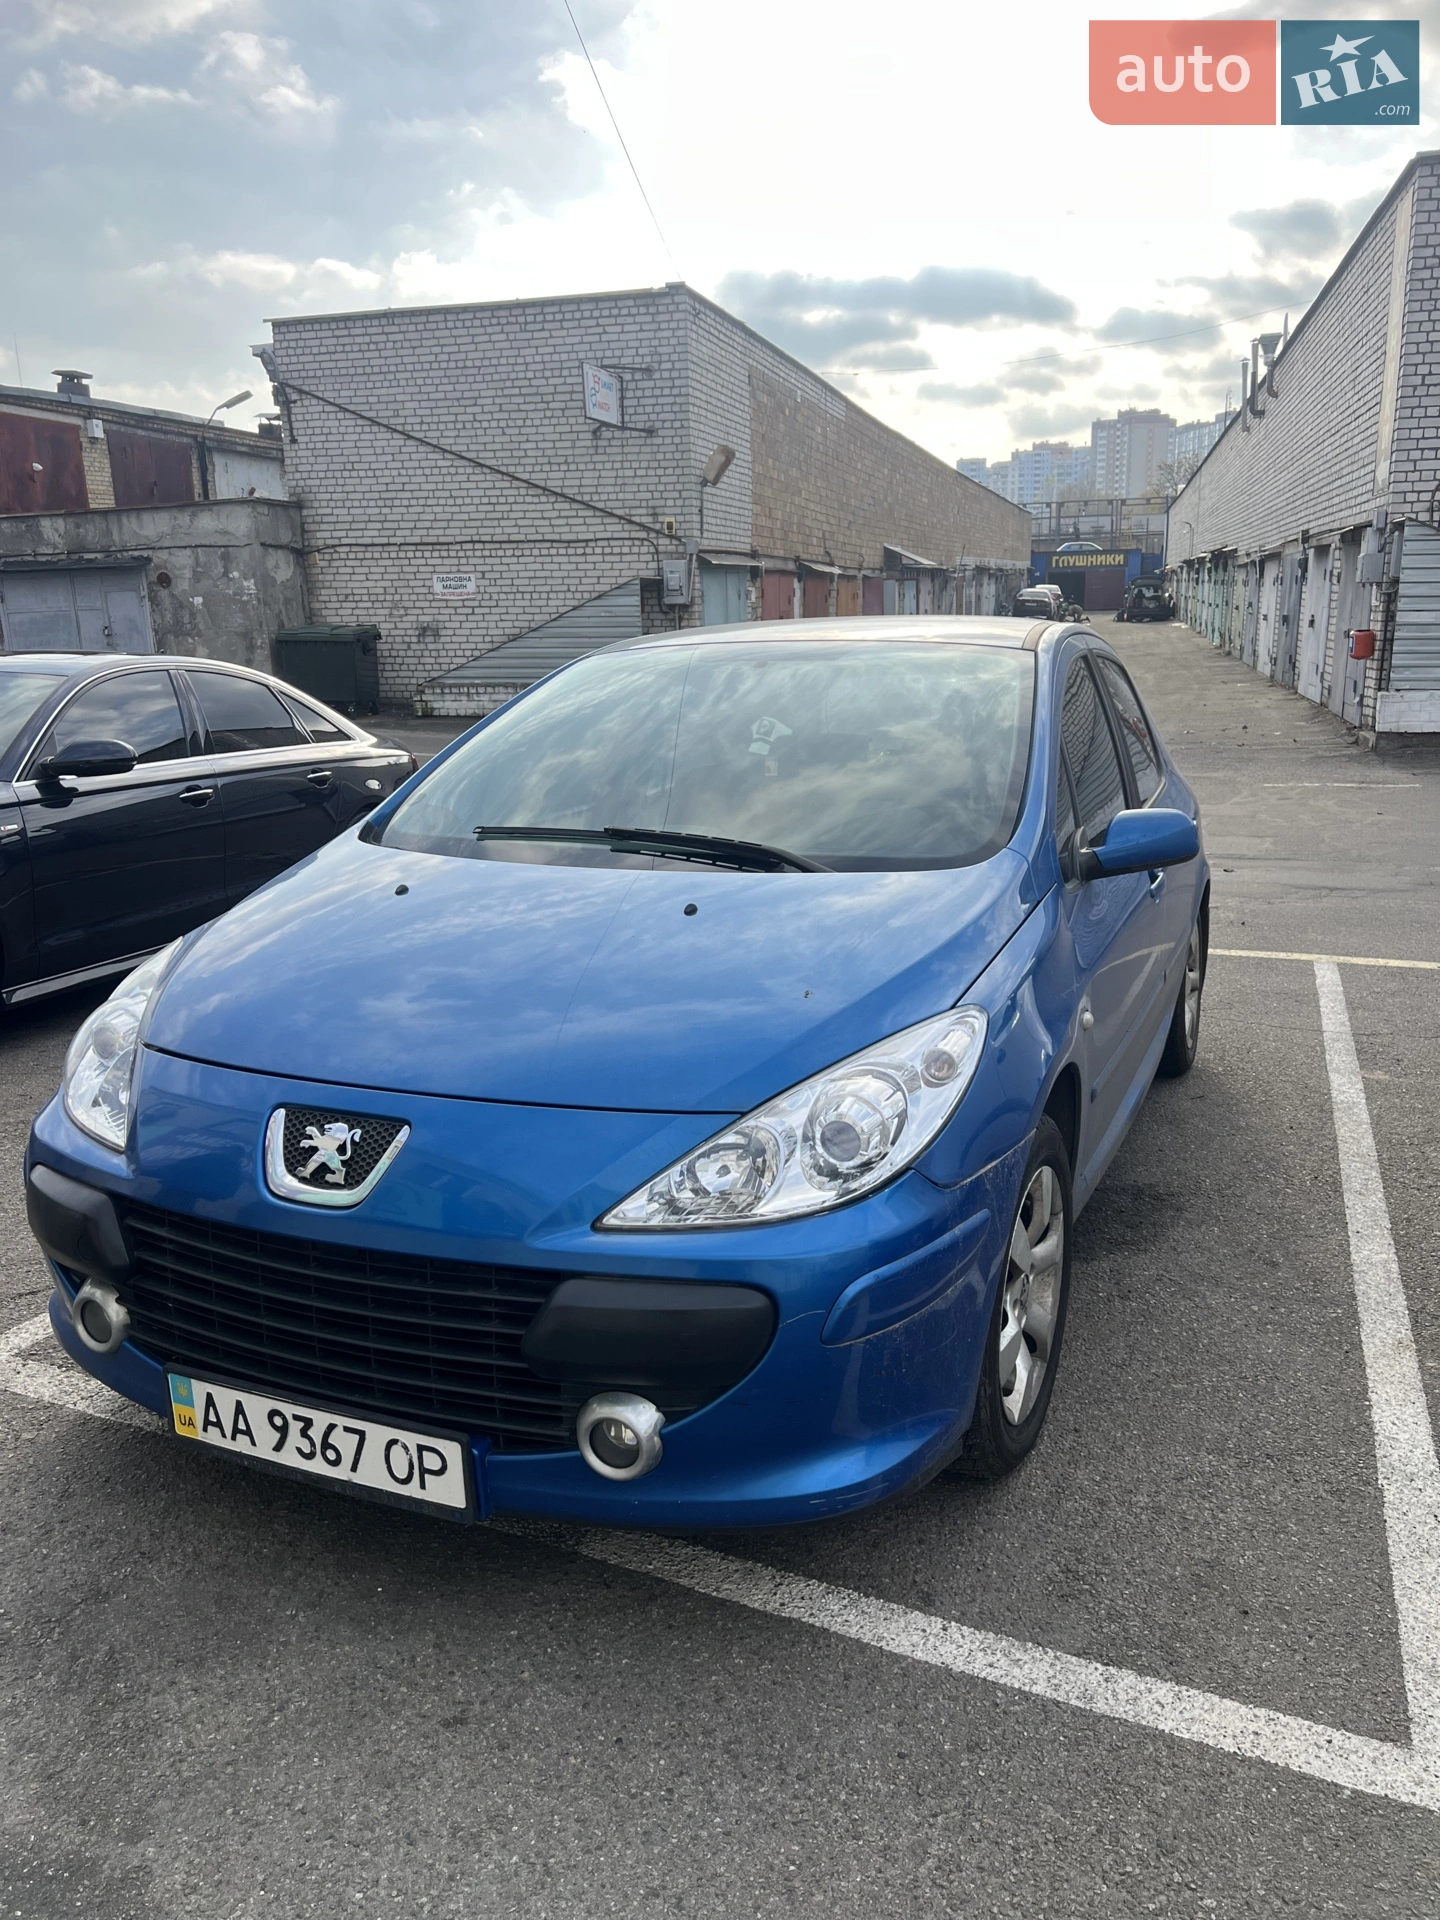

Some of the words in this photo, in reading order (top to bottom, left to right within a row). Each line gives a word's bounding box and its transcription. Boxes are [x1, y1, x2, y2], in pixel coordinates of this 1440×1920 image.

[1052, 554, 1124, 568] ГЛУШНИКИ
[178, 1413, 196, 1429] UA
[202, 1391, 257, 1447] AA
[267, 1408, 366, 1473] 9367
[384, 1438, 448, 1490] OP
